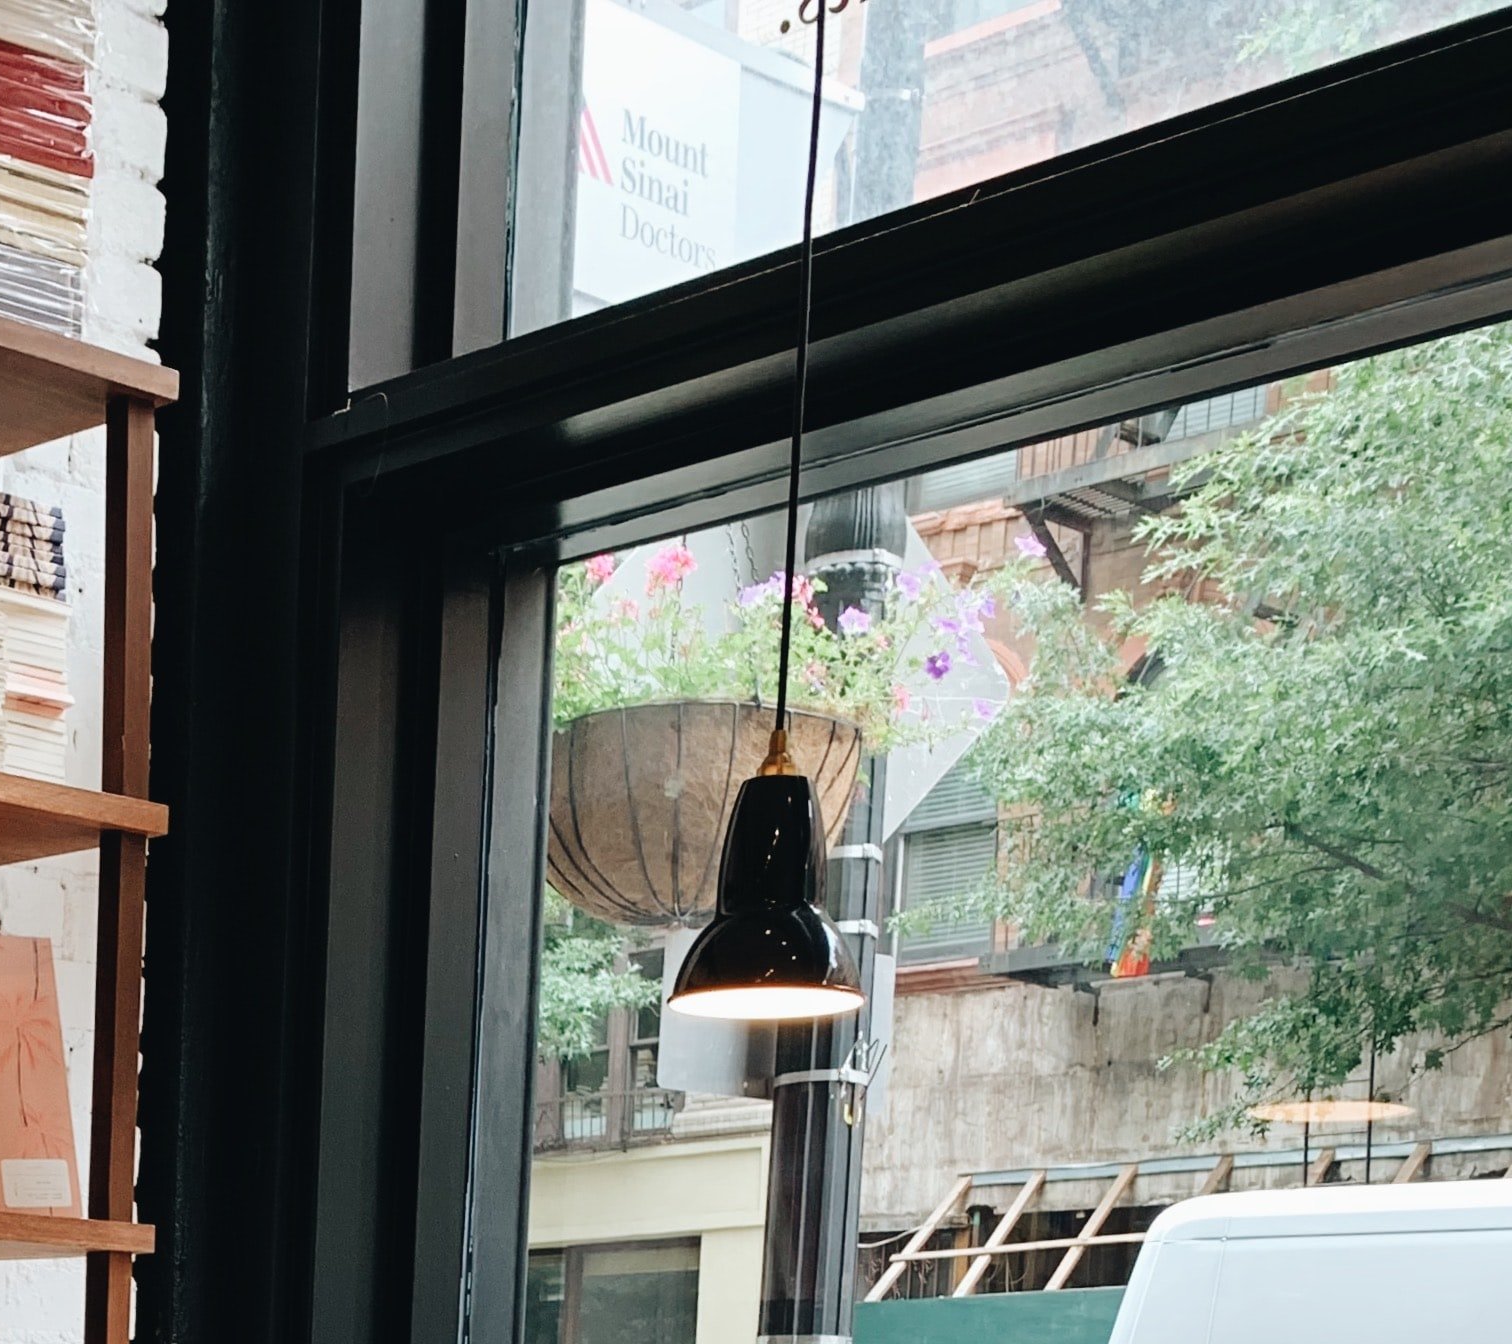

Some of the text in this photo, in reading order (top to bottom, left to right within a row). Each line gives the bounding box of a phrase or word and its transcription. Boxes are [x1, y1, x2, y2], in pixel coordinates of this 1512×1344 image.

[622, 108, 709, 179] Mount
[620, 156, 690, 217] Sinai
[619, 202, 717, 270] Doctors
